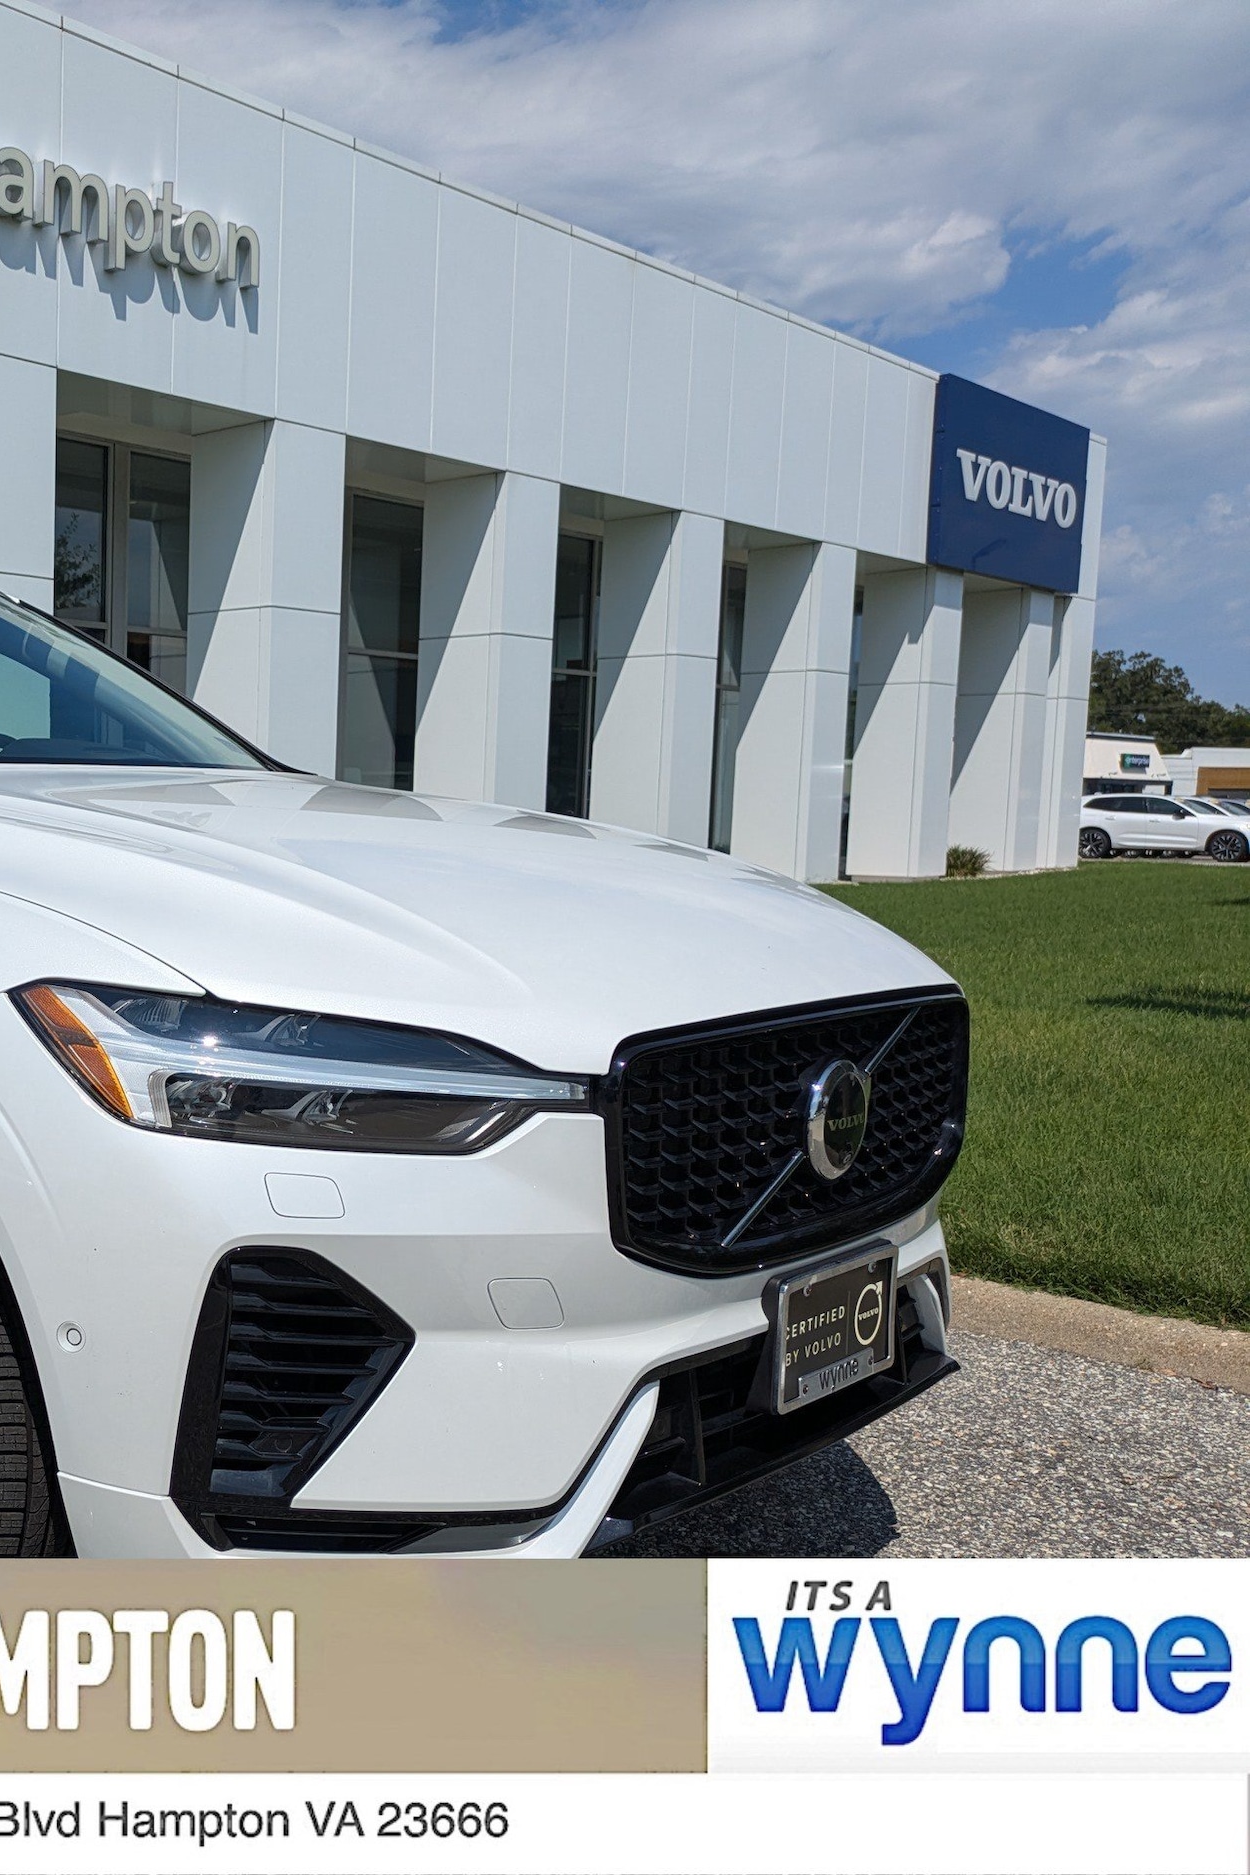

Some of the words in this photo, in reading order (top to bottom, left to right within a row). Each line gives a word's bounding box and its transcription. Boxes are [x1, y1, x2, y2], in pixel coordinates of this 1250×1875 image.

[956, 448, 1077, 528] VOLVO
[858, 1307, 879, 1320] VOLVO
[785, 1349, 800, 1367] BY
[805, 1332, 841, 1358] VOLVO
